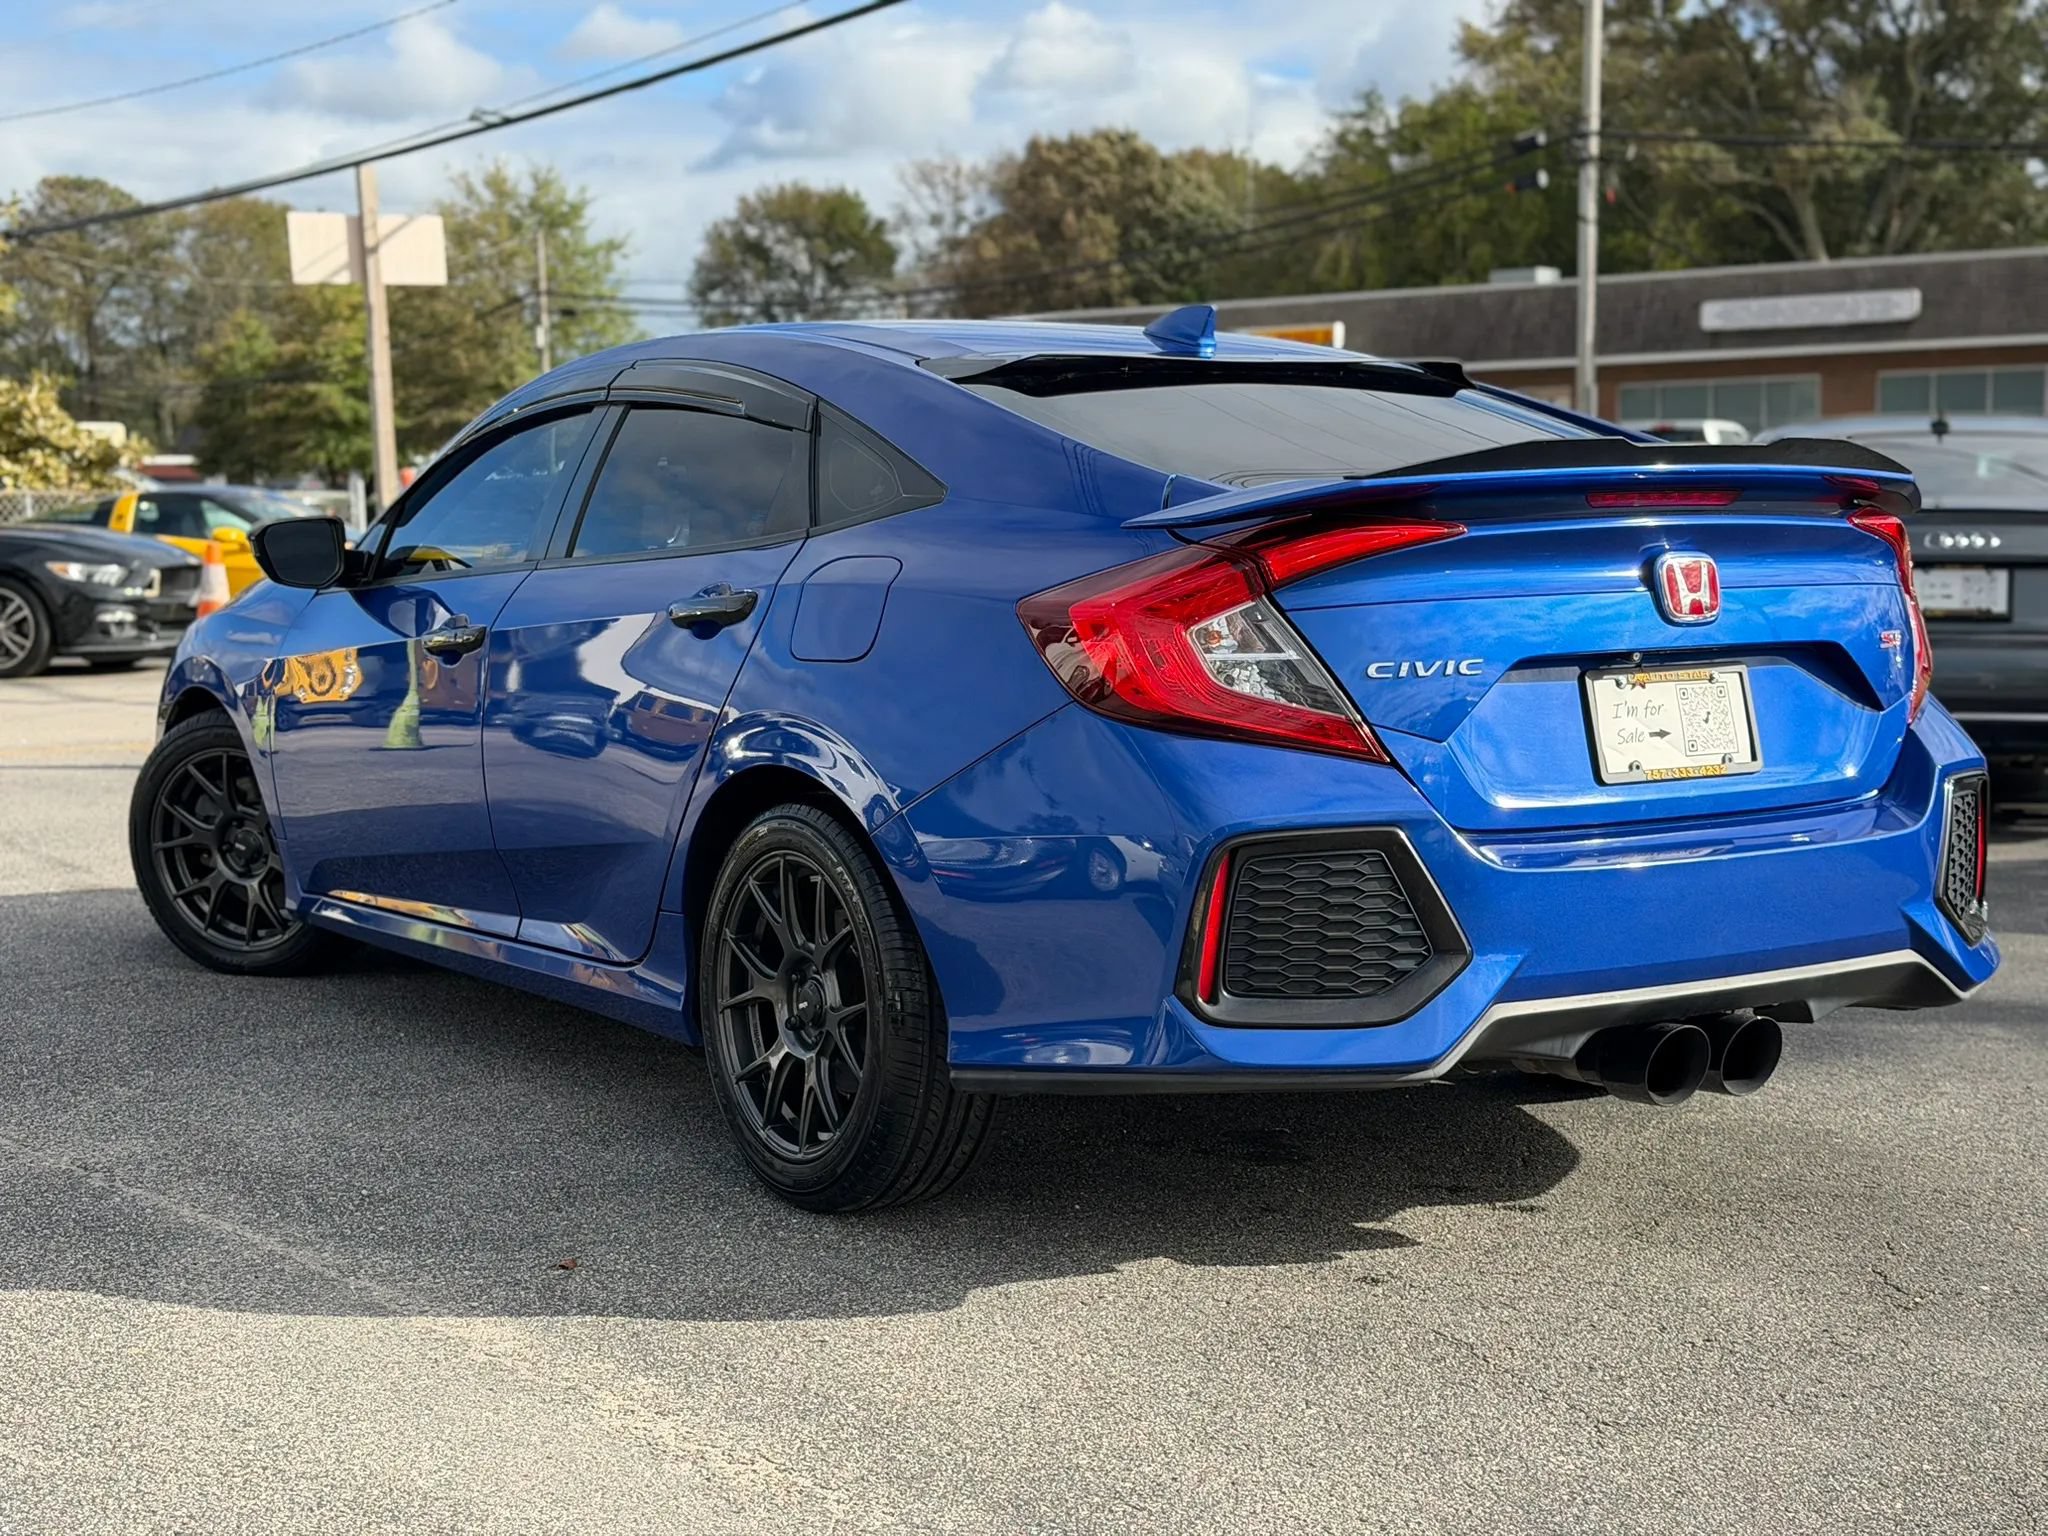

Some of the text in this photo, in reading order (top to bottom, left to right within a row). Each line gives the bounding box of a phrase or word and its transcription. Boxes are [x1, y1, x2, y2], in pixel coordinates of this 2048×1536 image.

[1366, 658, 1485, 679] CIVIC
[1611, 699, 1665, 720] I'm for
[1616, 727, 1646, 745] Sale
